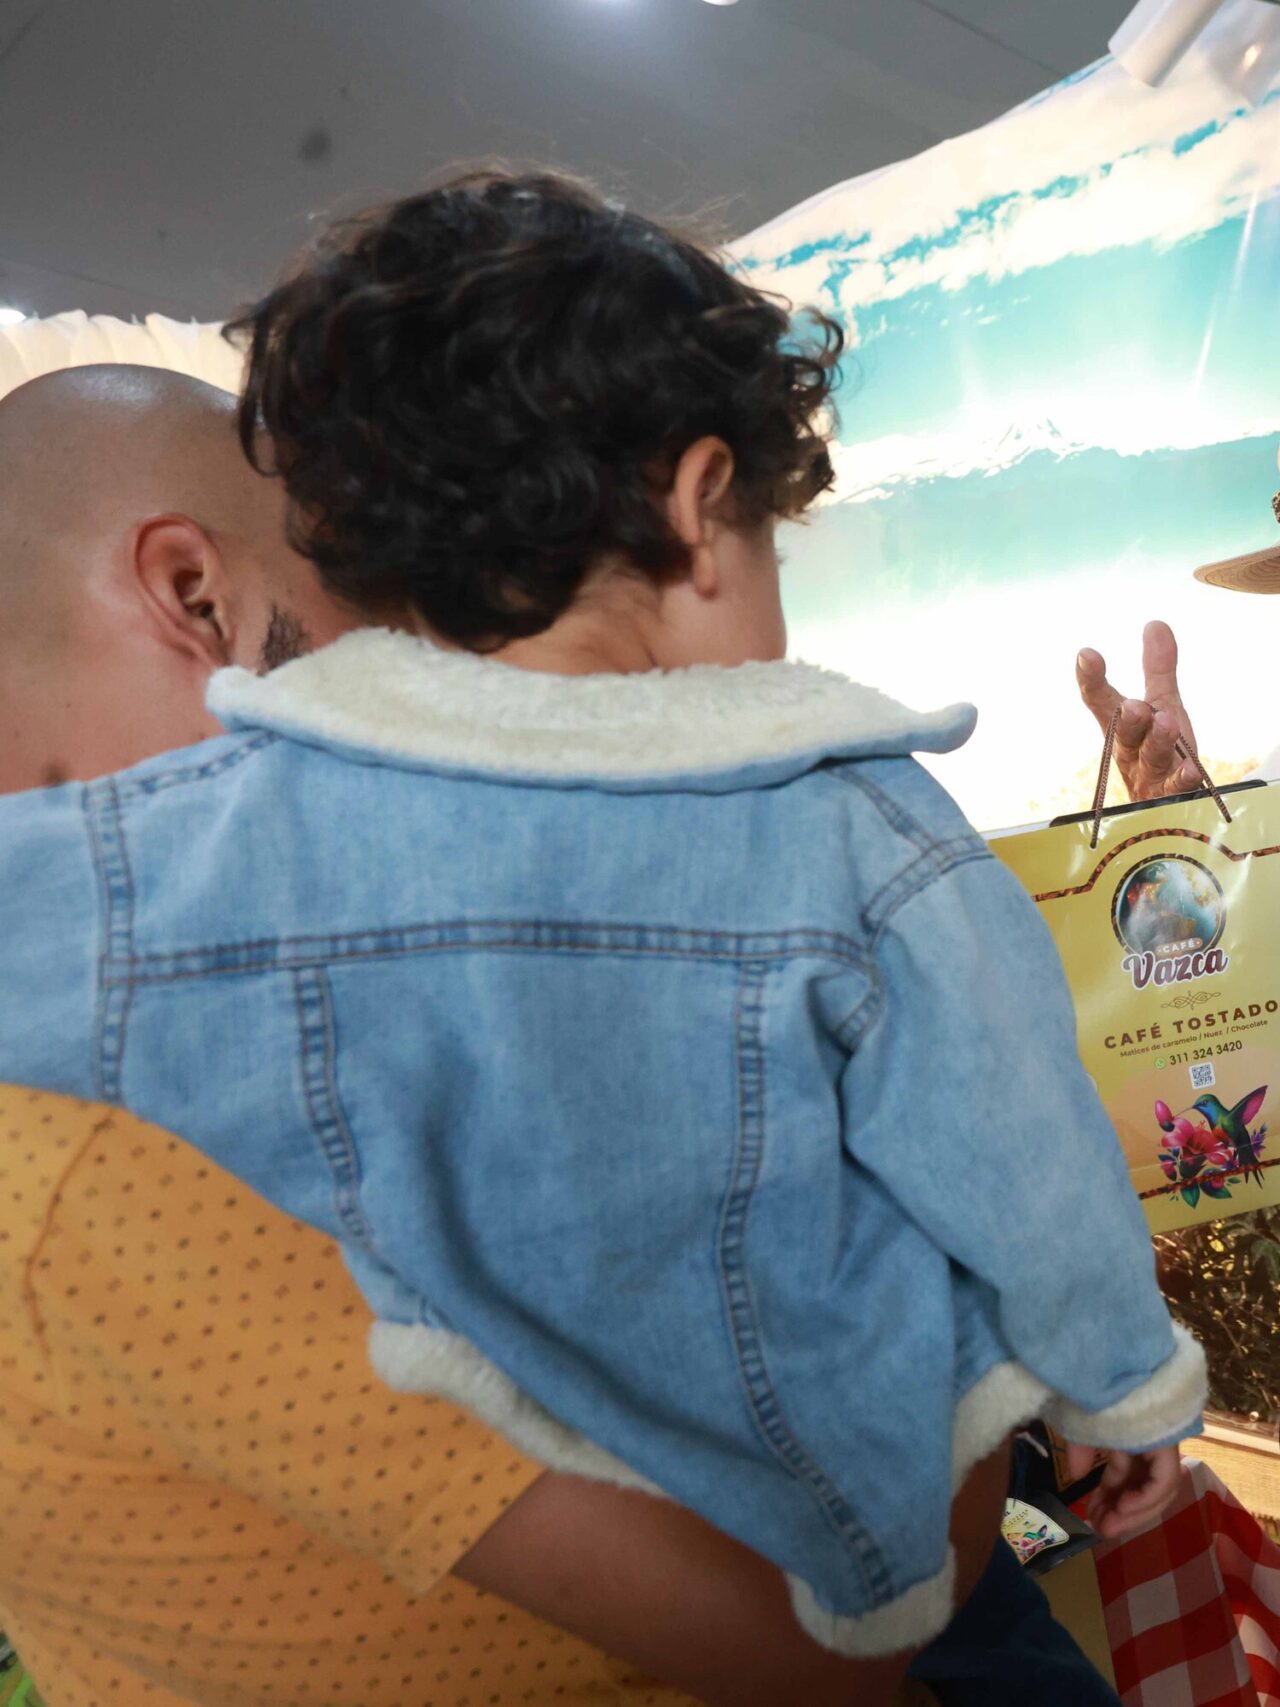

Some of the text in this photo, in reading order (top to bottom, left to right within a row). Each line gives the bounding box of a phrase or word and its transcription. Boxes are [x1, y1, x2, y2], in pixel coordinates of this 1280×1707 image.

[1162, 938, 1196, 954] CAFÉ
[1121, 947, 1229, 990] Vazca
[1104, 1000, 1279, 1049] CAFÉ TOSTADO
[1120, 1046, 1150, 1058] Matices
[1151, 1043, 1161, 1051] de
[1163, 1036, 1198, 1049] caramelo
[1204, 1029, 1223, 1039] Nuez
[1231, 1019, 1268, 1033] Chocolate
[1169, 1040, 1243, 1065] 311 324 3420
